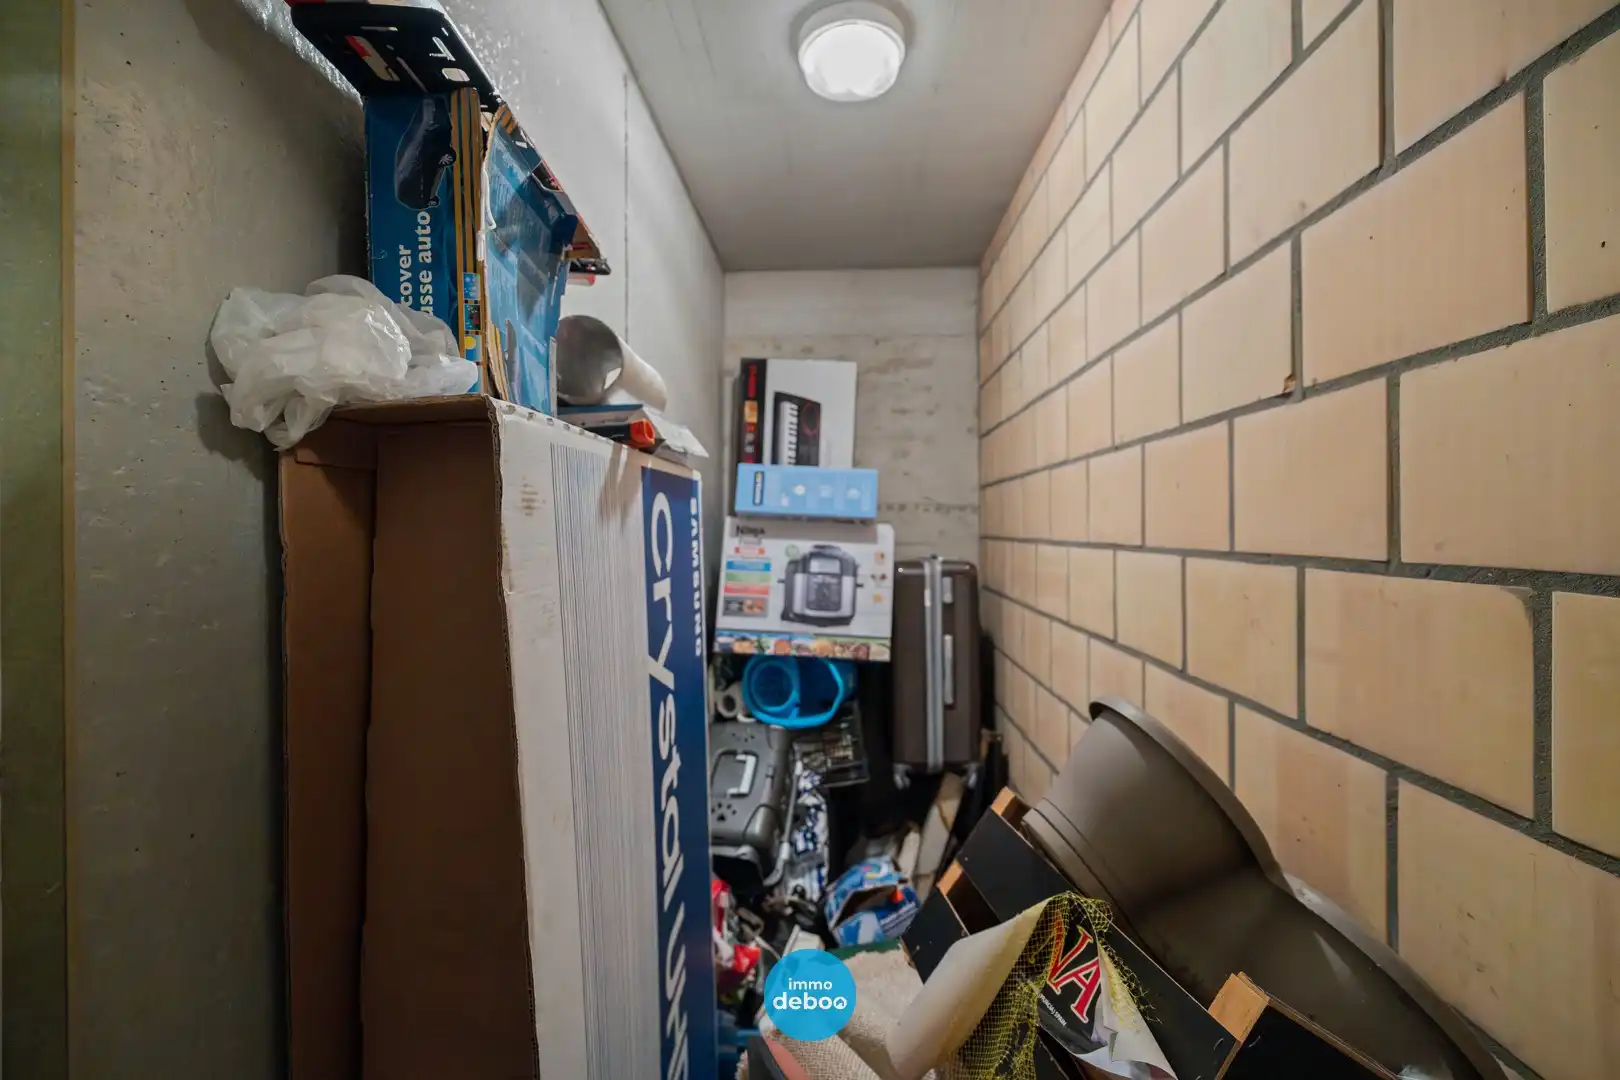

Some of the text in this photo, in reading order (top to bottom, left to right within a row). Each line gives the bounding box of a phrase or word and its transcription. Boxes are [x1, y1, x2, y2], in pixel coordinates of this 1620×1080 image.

[415, 211, 433, 263] auto
[399, 244, 413, 307] cover
[690, 497, 702, 657] SAMSUNG
[648, 491, 685, 913] Crystal
[1054, 1010, 1067, 1027] SPAIN
